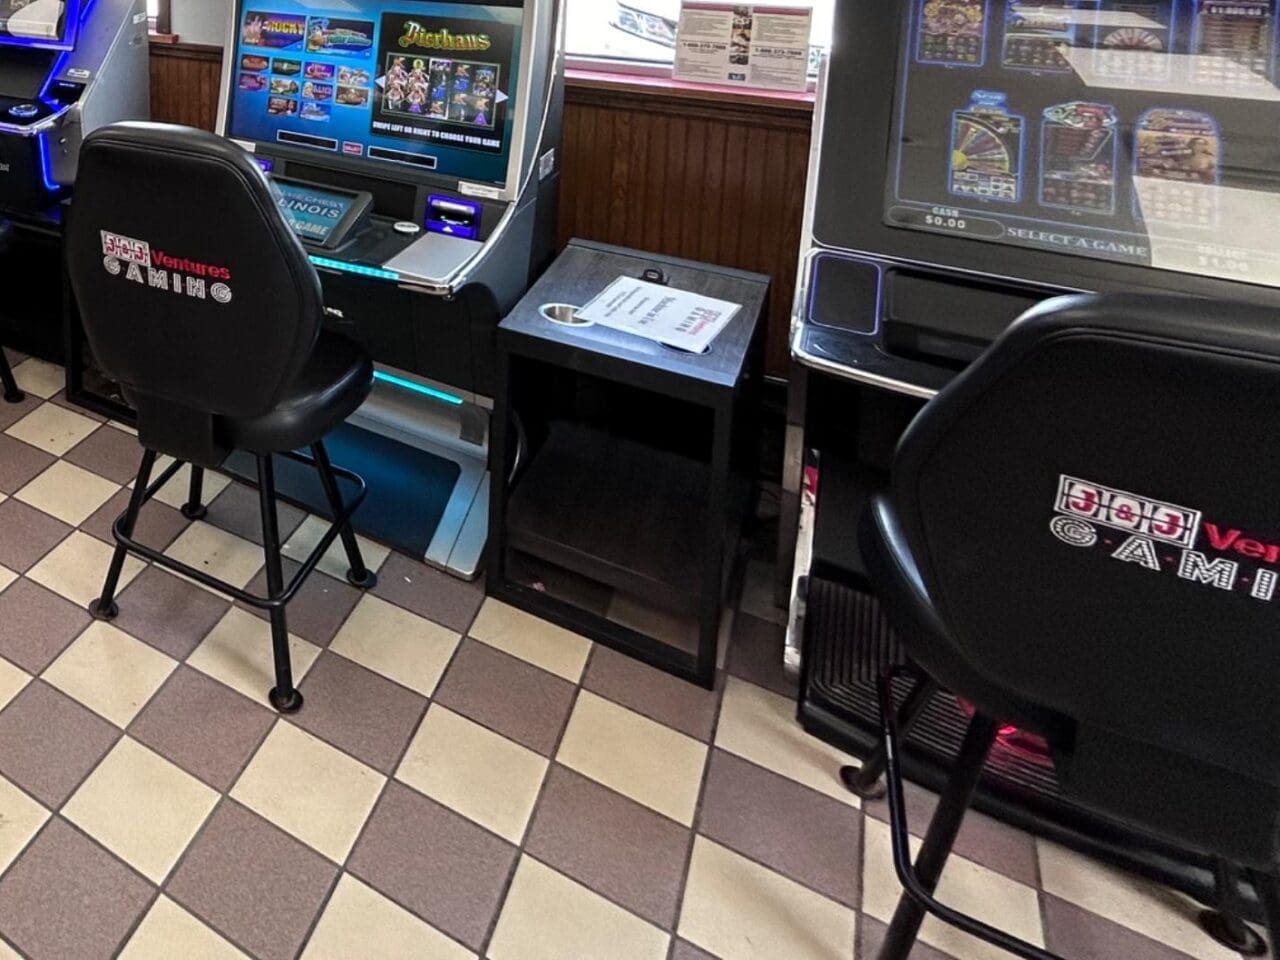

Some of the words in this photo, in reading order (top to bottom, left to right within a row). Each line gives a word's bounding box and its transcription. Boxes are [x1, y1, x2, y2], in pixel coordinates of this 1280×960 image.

[925, 215, 966, 229] $0.00
[931, 206, 959, 218] CASH
[295, 221, 329, 236] GAME
[1007, 226, 1073, 245] SELECT
[1076, 238, 1089, 248] A
[1092, 240, 1147, 257] GAME
[151, 248, 231, 280] Ventures
[103, 255, 233, 303] GAMING
